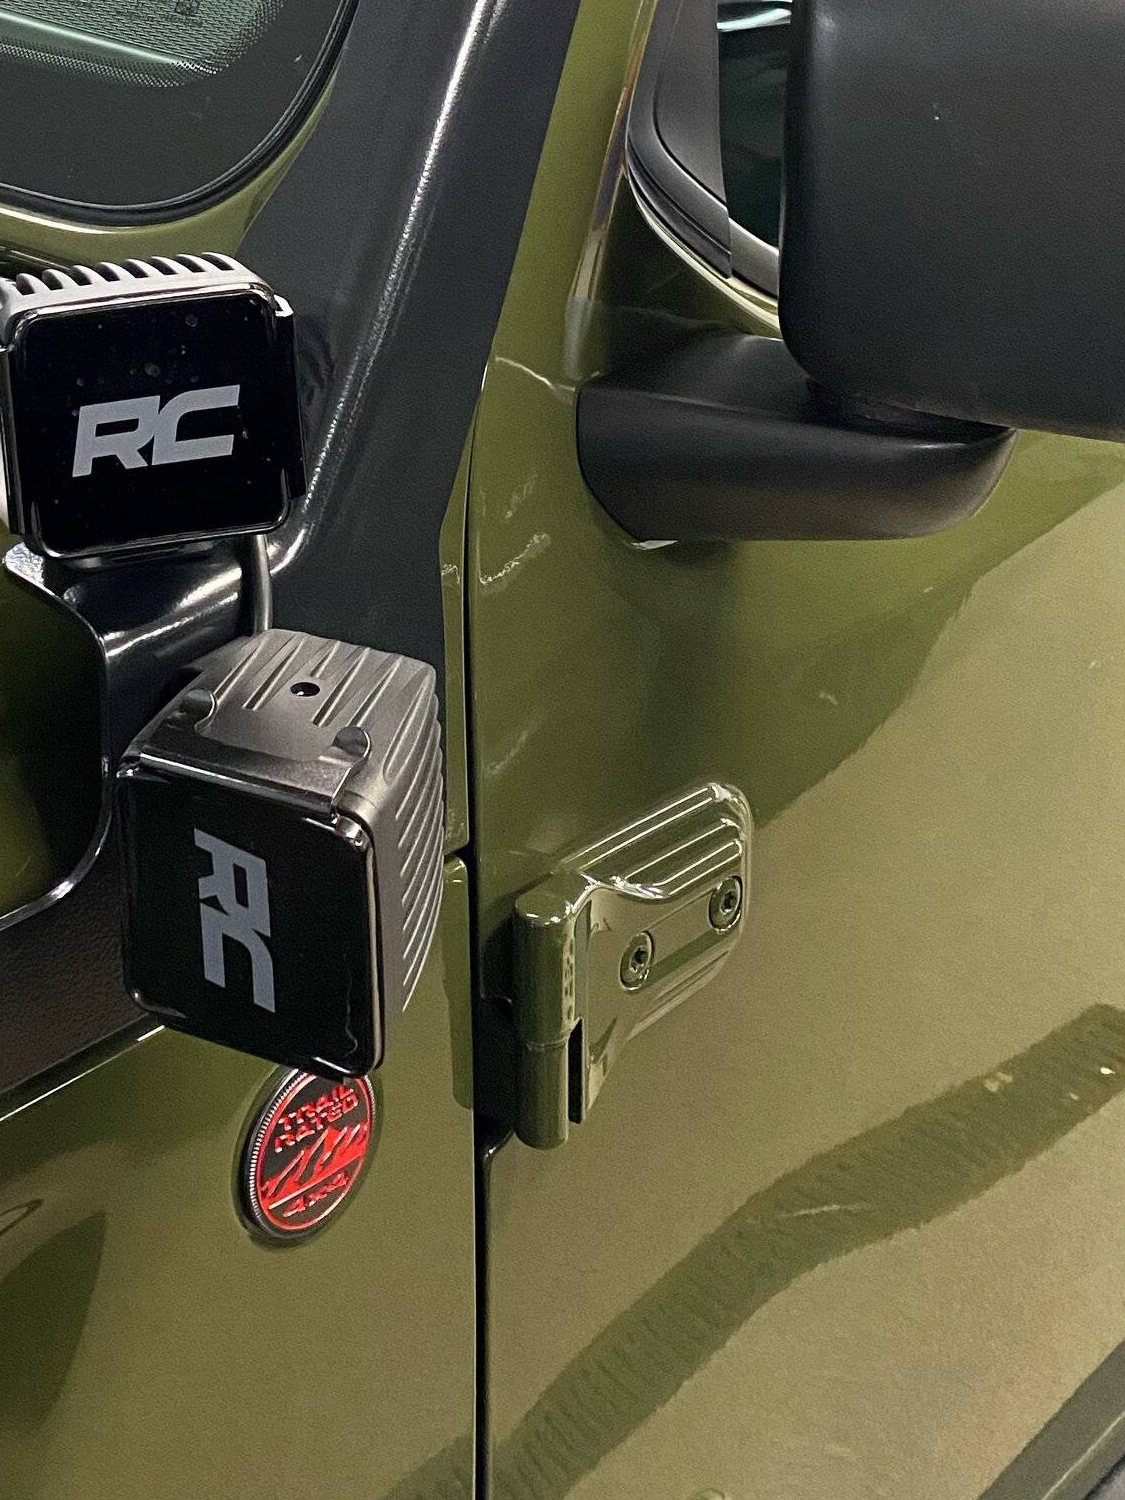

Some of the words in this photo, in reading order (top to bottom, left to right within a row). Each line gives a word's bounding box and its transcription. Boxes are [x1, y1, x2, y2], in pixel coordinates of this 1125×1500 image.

[72, 383, 240, 478] RC
[194, 828, 276, 1013] RC
[275, 1094, 359, 1153] RATED
